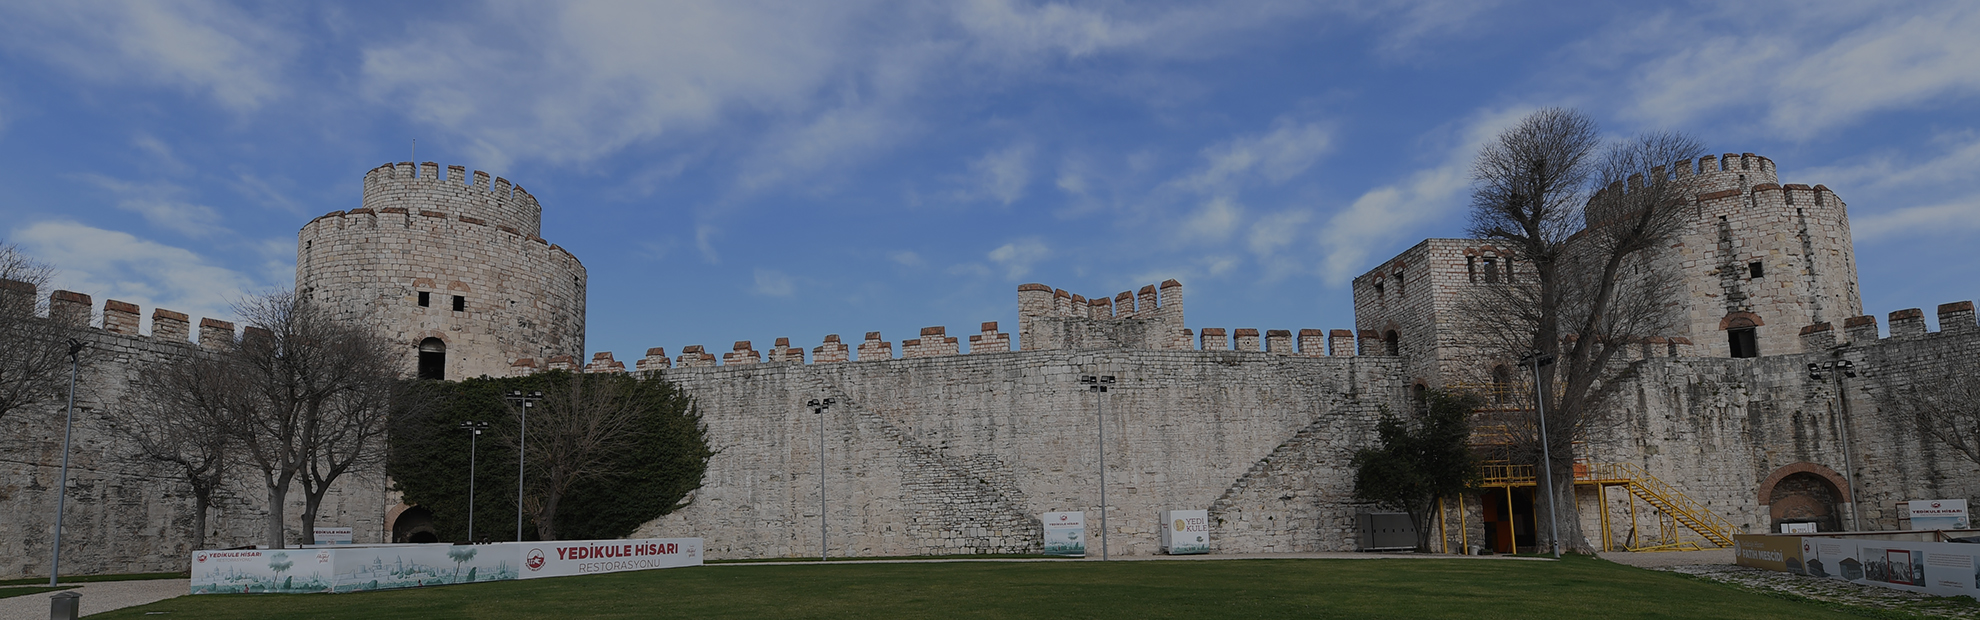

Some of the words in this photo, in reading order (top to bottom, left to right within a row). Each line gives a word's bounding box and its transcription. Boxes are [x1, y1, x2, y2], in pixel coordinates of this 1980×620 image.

[1185, 516, 1205, 525] YEDİ
[1186, 525, 1208, 533] KULE
[557, 542, 632, 560] YEDİKULE
[635, 540, 679, 556] HİSARI
[1742, 547, 1758, 560] FATİH
[1758, 549, 1784, 563] MESCİDİ
[578, 559, 661, 573] RESTORASYONU
